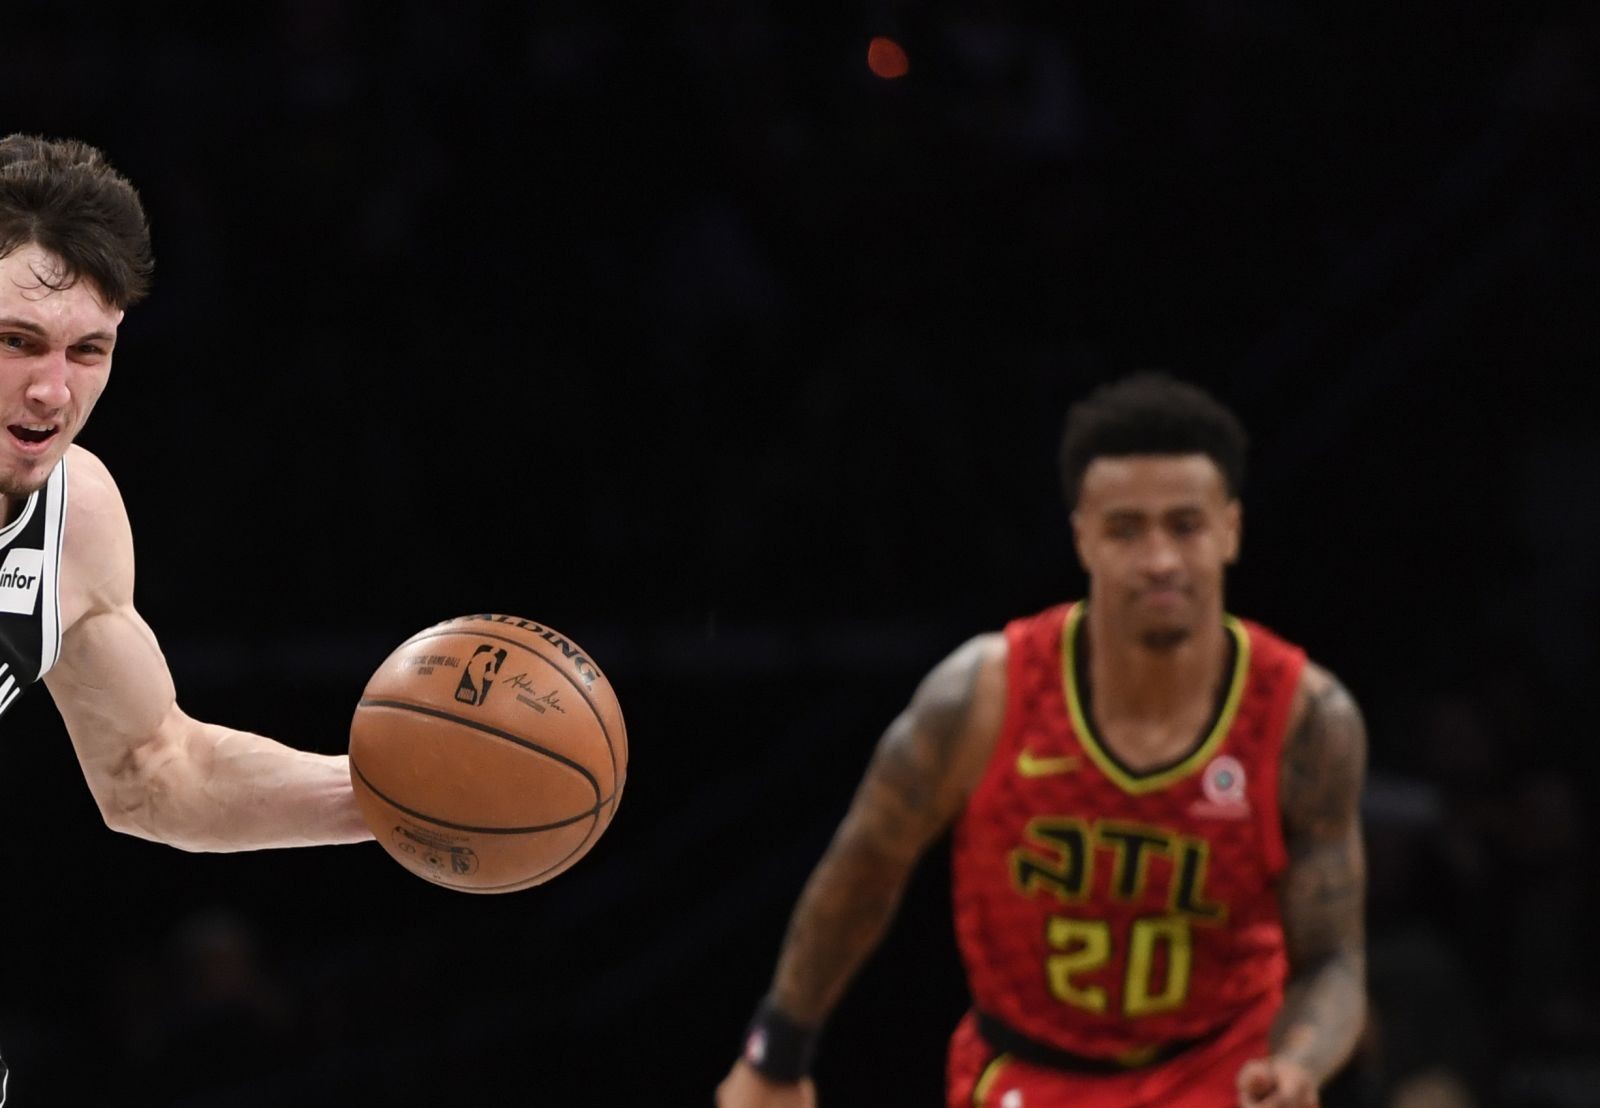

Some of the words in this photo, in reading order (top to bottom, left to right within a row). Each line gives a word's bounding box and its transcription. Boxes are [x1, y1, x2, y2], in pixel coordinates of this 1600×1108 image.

[0, 566, 36, 590] infor
[1009, 816, 1227, 922] ATL
[1045, 915, 1193, 1018] 20
